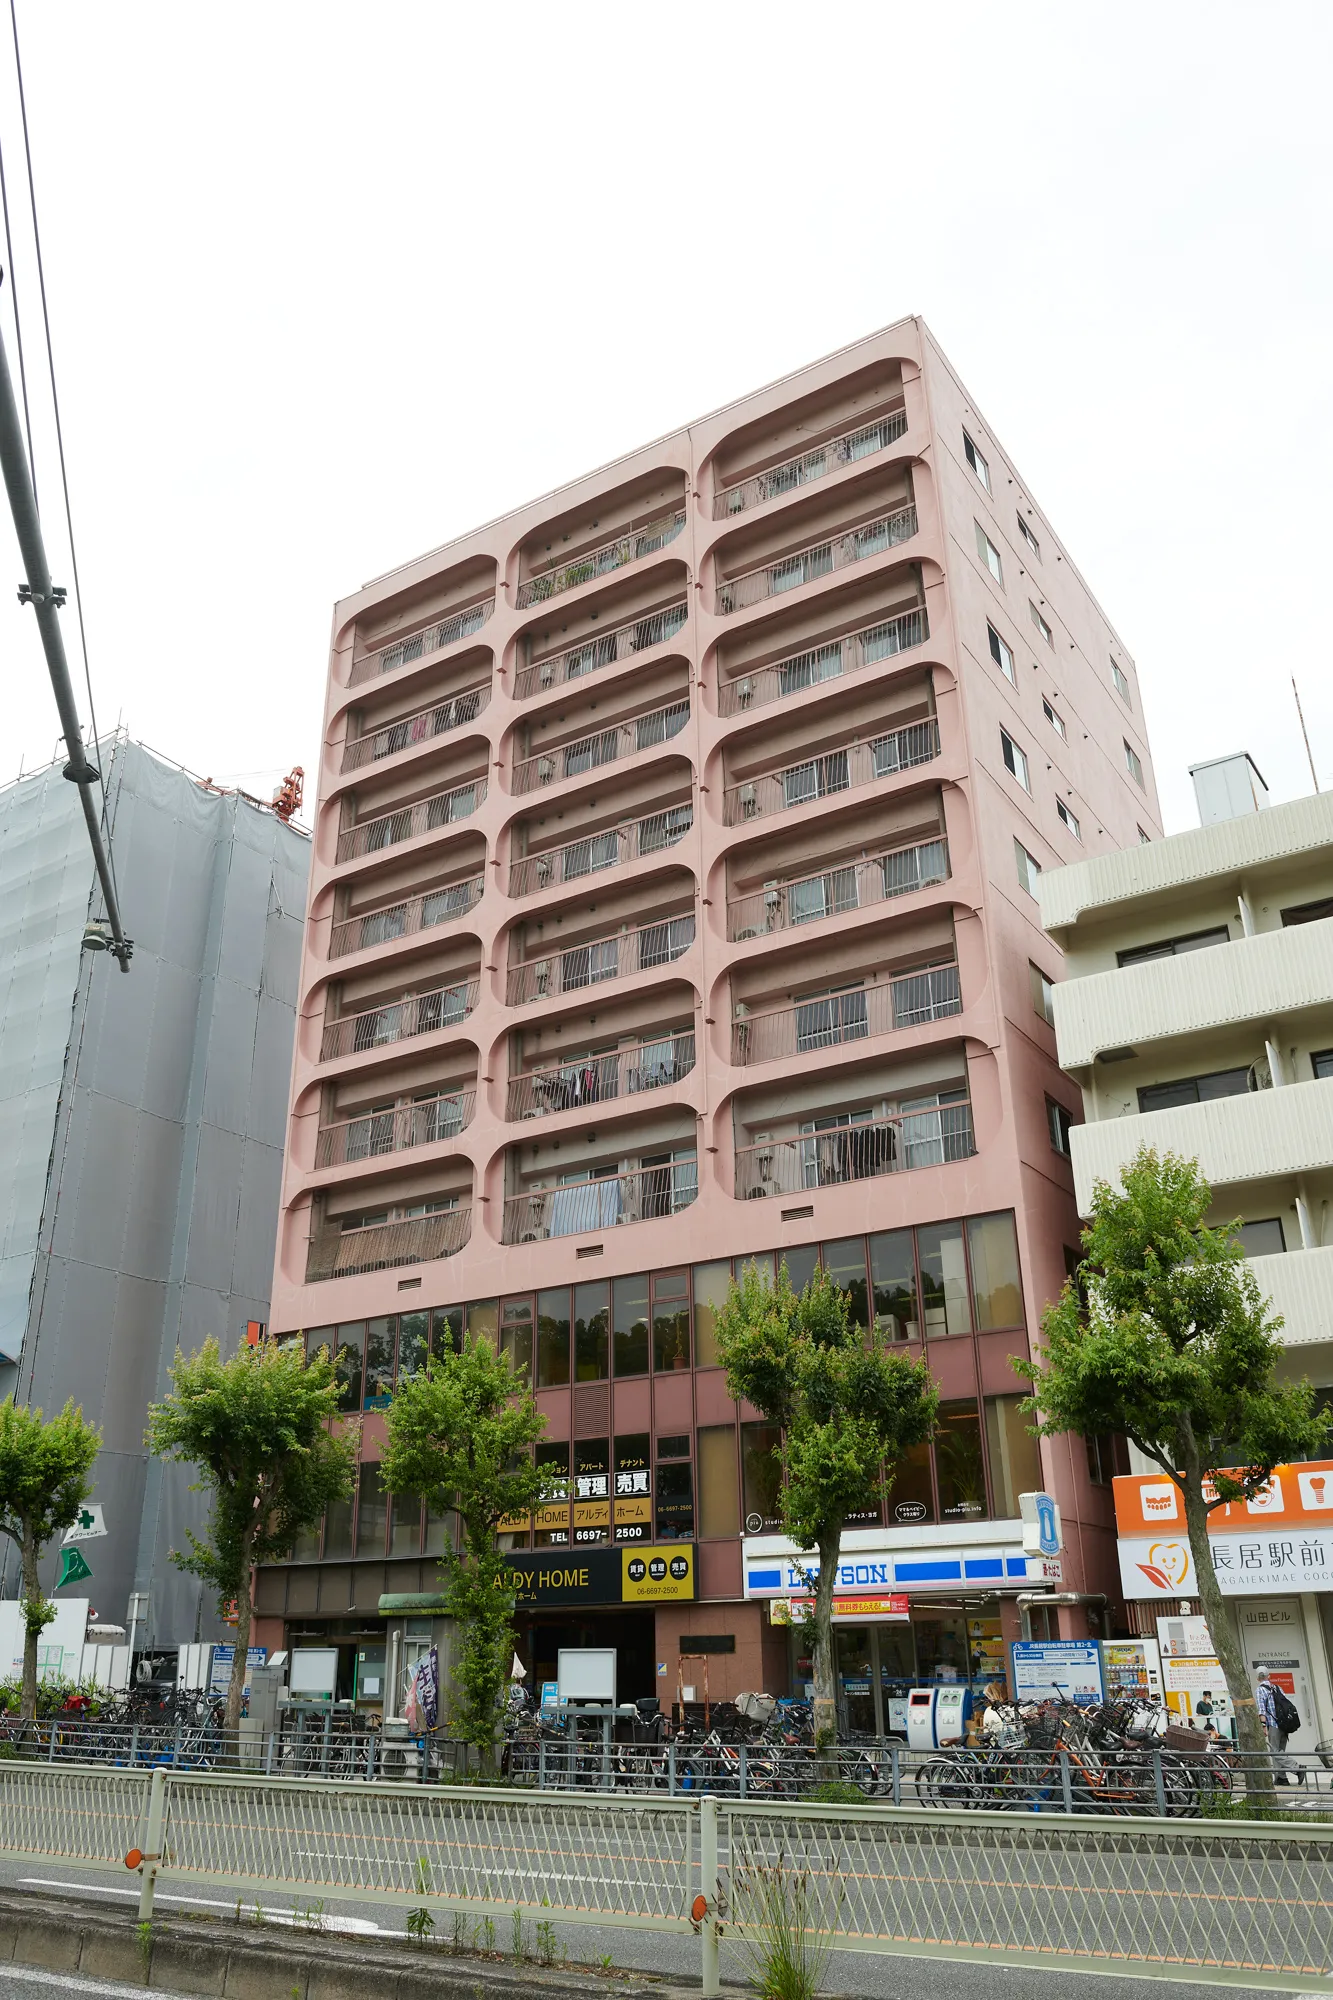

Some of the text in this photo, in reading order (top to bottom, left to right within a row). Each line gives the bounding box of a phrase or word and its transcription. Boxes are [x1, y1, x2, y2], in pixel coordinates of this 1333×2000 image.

[580, 1462, 604, 1471] アパート
[620, 1458, 645, 1468] テナント
[577, 1476, 607, 1496] 管理
[617, 1472, 648, 1493] 売買
[537, 1511, 568, 1524] HOME
[577, 1506, 644, 1520] アルディ ホーム
[844, 1511, 878, 1520] ラティス・ヨガ
[550, 1527, 642, 1542] TEL 6697- 2500
[1212, 1539, 1333, 1570] 長居駅前
[539, 1568, 589, 1588] HOME
[787, 1564, 888, 1588] LASON
[1216, 1573, 1297, 1585] AGAIEKIMAE
[515, 1591, 537, 1600] ホーム
[636, 1586, 679, 1595] 06-6697-2500
[1246, 1611, 1291, 1623] 山田ビル
